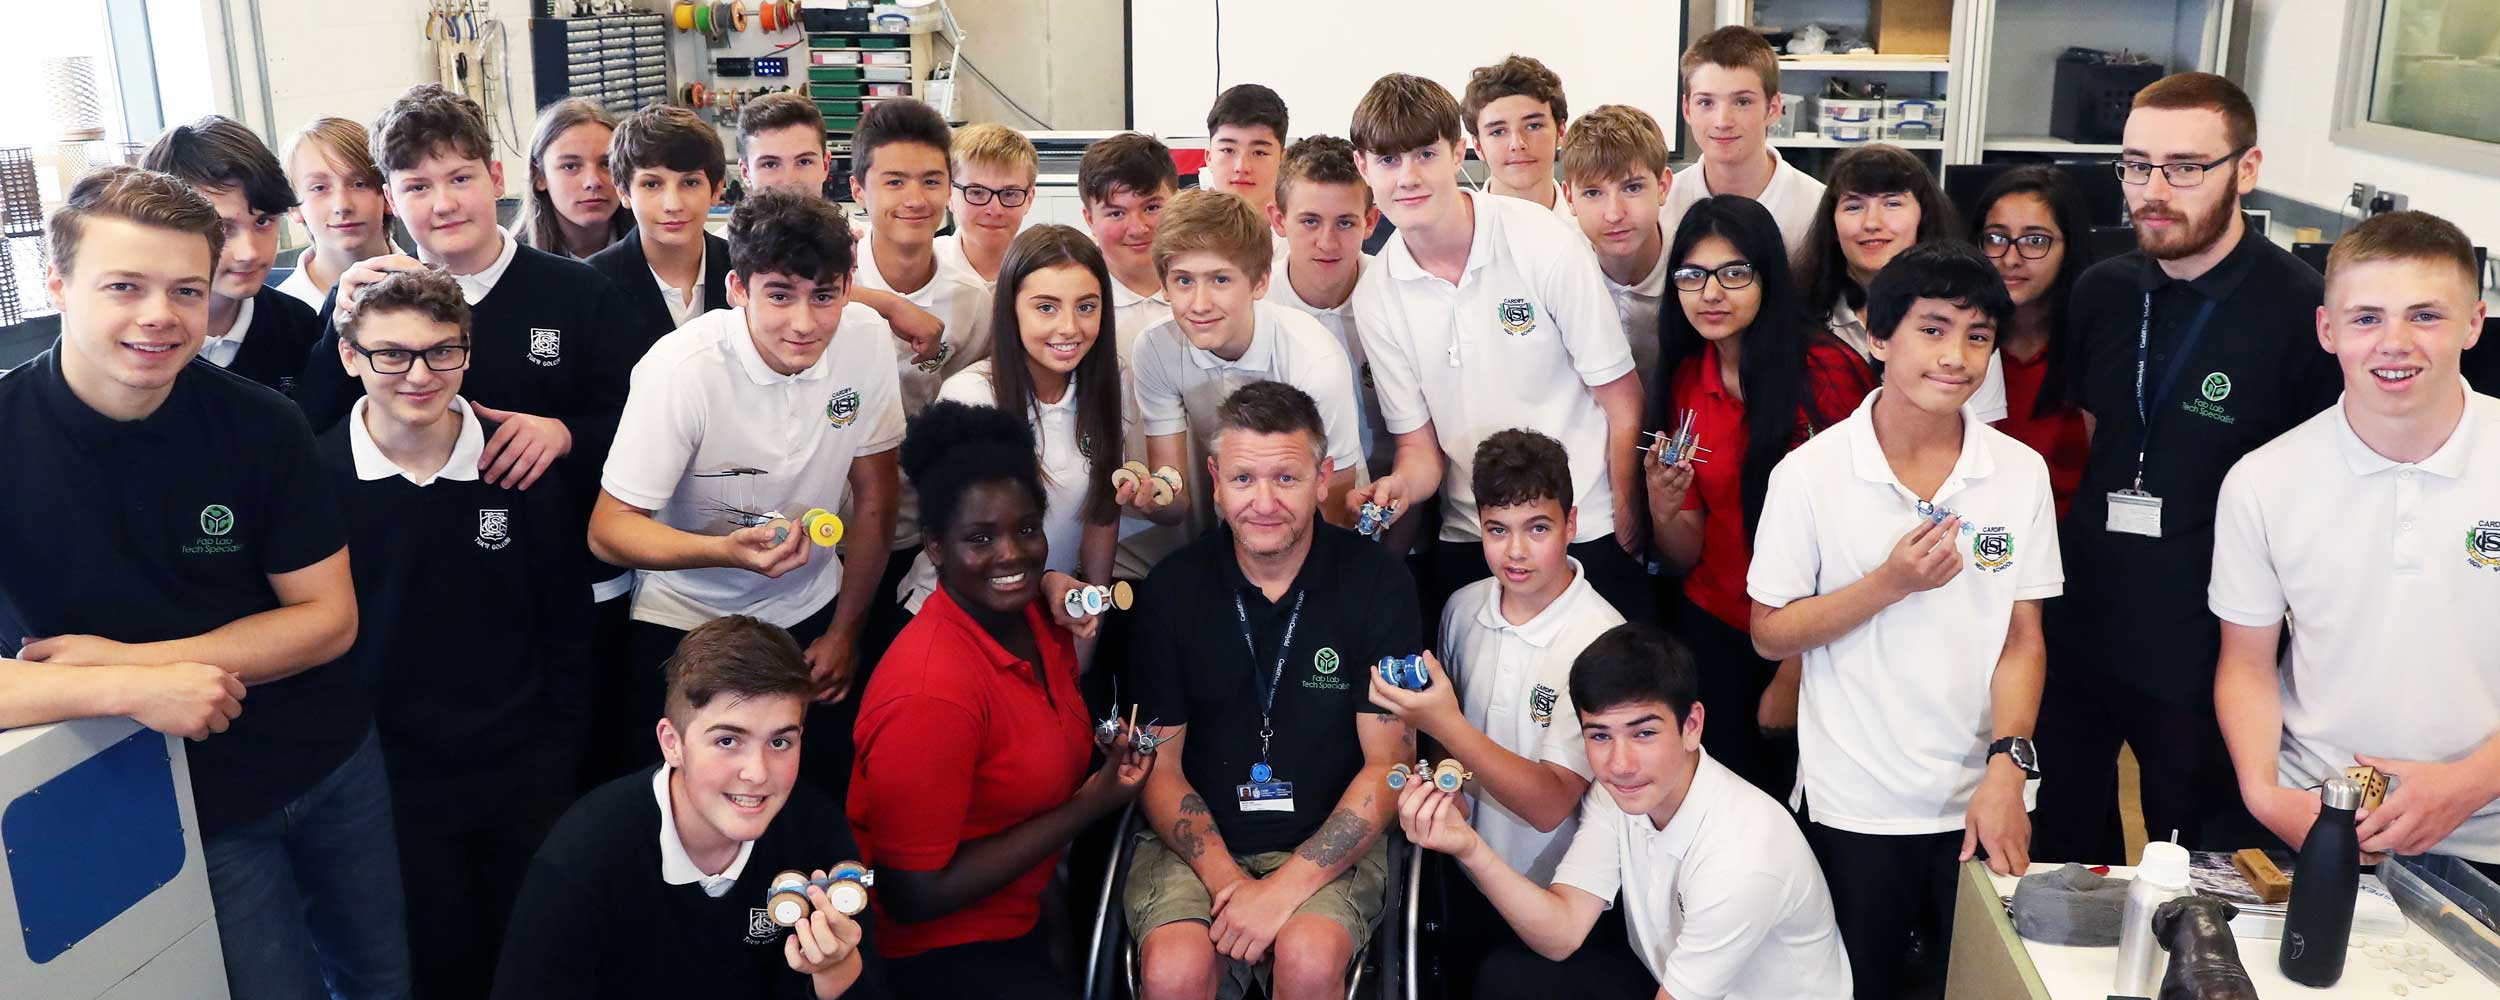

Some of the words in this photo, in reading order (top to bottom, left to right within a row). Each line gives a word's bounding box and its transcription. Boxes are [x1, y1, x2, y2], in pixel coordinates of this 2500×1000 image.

[2182, 401, 2199, 413] Tech
[2194, 398, 2209, 409] Fab
[2210, 403, 2225, 413] Lab
[2478, 520, 2500, 528] CARD
[182, 545, 204, 553] Tech
[1992, 560, 2013, 573] SCHOOL
[1312, 674, 1326, 682] Fab
[1327, 675, 1340, 683] Lab
[1302, 680, 1319, 689] Tech
[1536, 683, 1555, 694] CARDIFF
